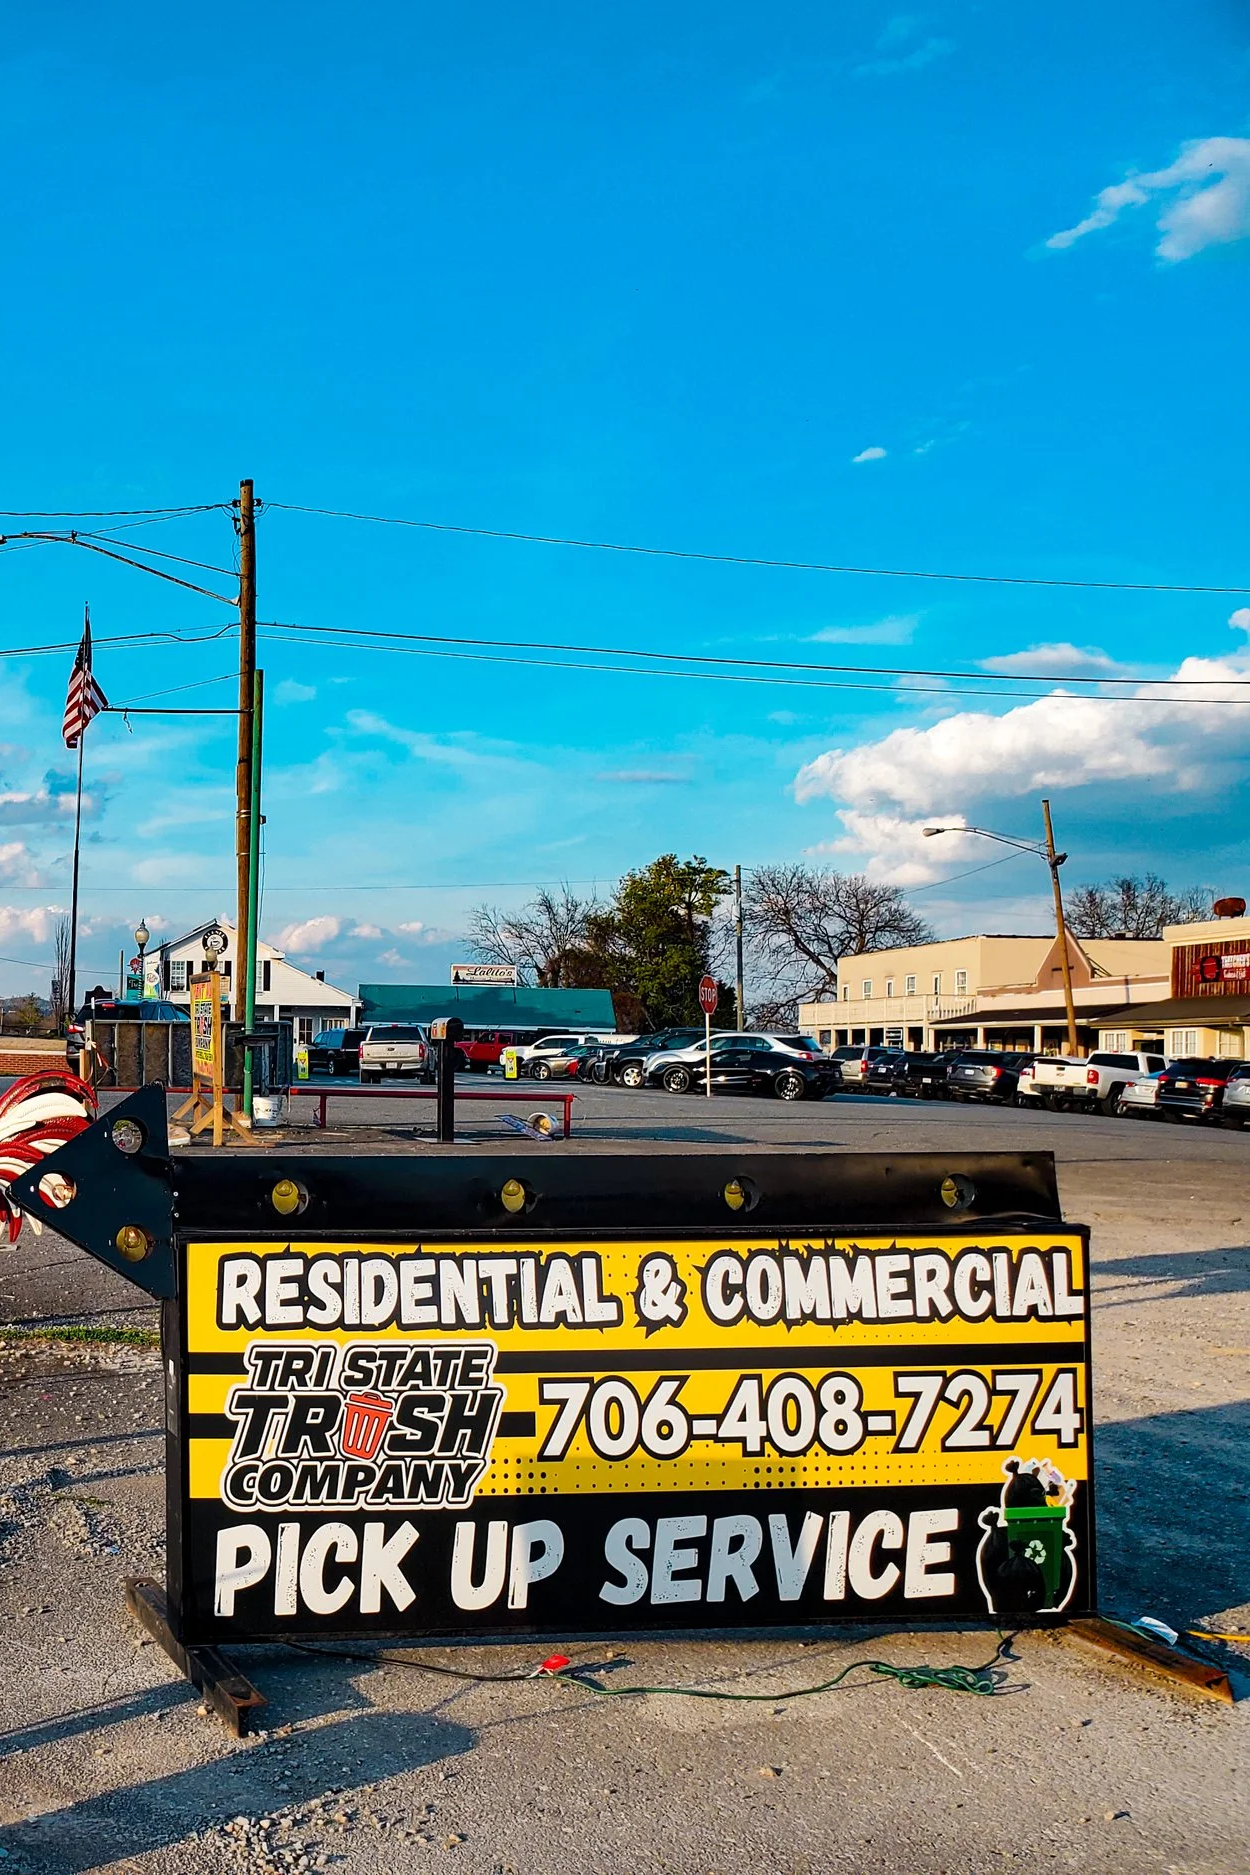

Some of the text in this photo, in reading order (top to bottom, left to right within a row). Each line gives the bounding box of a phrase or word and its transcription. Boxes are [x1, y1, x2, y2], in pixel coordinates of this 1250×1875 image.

[701, 986, 717, 1003] STOP
[219, 1253, 1084, 1327] RESIDENTIAL & COMMERCIAL
[250, 1345, 493, 1390] TRI STATE
[231, 1390, 501, 1461] TRSH
[541, 1371, 1081, 1458] 706-408-7274
[227, 1461, 482, 1504] COMPANY
[215, 1508, 959, 1616] PICK UP SERVICE
